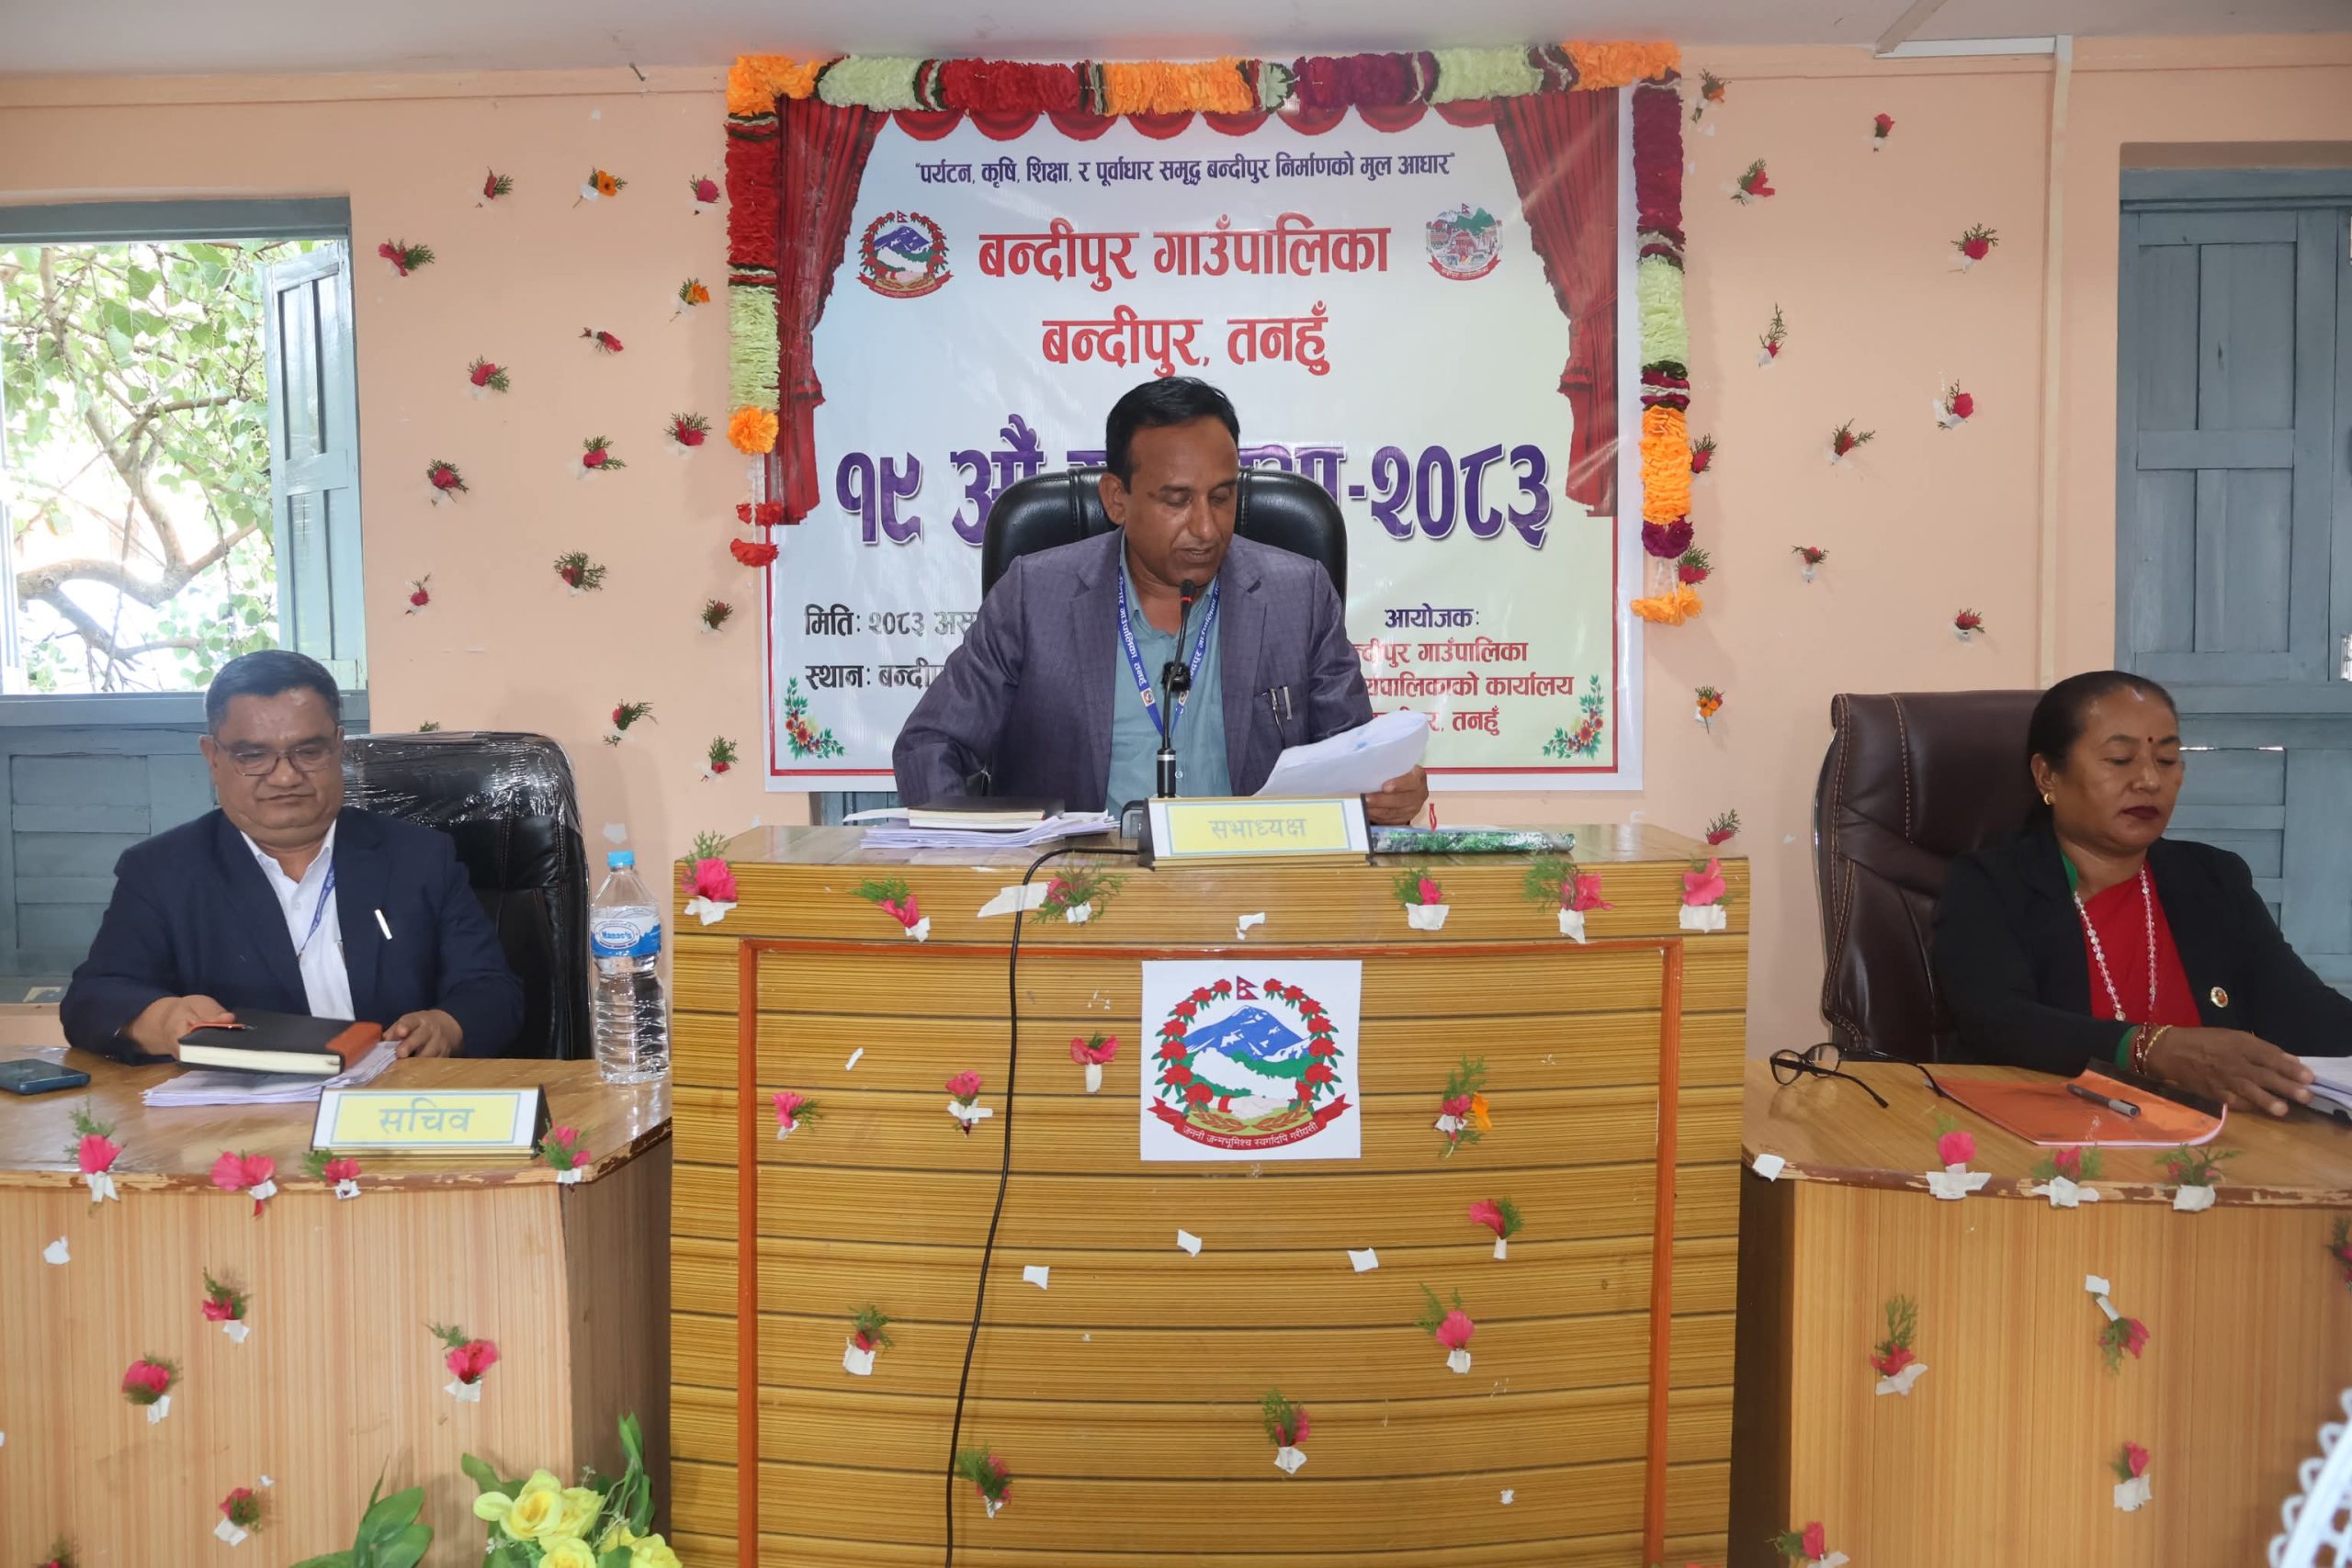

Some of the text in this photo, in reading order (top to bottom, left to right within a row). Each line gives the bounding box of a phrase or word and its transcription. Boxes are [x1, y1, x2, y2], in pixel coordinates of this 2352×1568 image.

[982, 156, 1021, 187] कृषि,
[1026, 156, 1072, 184] शिक्षा,
[1079, 161, 1090, 182] र
[1096, 156, 1154, 186] पूर्वाधार
[1207, 153, 1271, 184] बन्दीपुर
[1275, 151, 1355, 177] निर्माणको
[1361, 154, 1392, 181] मुल
[978, 211, 1392, 292] बन्दीपुर गाउँपालिका
[1042, 299, 1330, 378] बन्दीपुर, तनहुँ
[836, 451, 922, 545] १५
[805, 604, 861, 637] मिति:
[868, 611, 925, 637] २०८३
[1385, 603, 1480, 628] आयोजक:
[1418, 636, 1529, 662] गाउँपालिका
[805, 658, 945, 690] स्थान: बन्दी
[1486, 671, 1575, 697] कार्यालय
[1452, 705, 1500, 736] तनहुँ
[1209, 818, 1307, 840] सभाध्यक्ष
[379, 1097, 475, 1134] सचिव
[1182, 1125, 1204, 1140] जननी
[1290, 1121, 1318, 1139] गरीयसी
